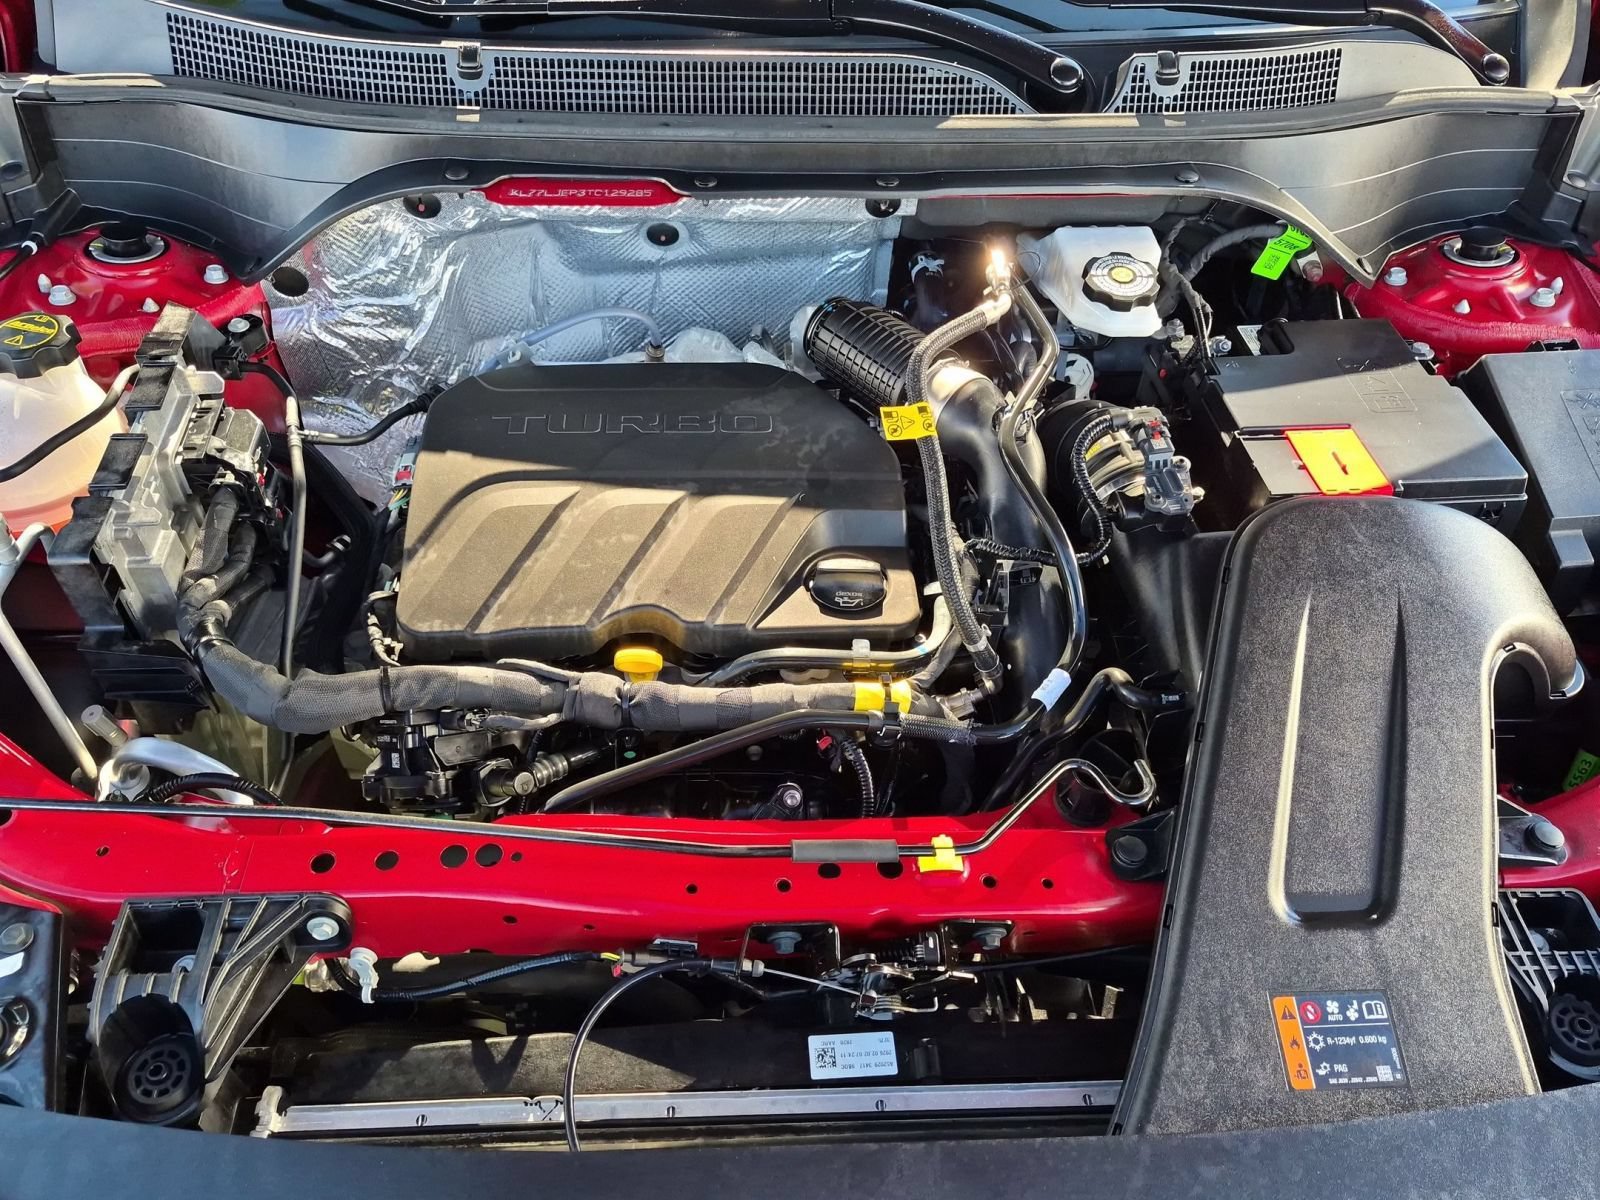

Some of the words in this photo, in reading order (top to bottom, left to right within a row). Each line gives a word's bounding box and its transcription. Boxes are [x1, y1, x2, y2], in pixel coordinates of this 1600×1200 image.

[492, 413, 773, 435] TURBO
[1326, 1036, 1356, 1046] R-1234yf
[1378, 1035, 1387, 1045] kg
[1333, 1064, 1348, 1072] PAG
